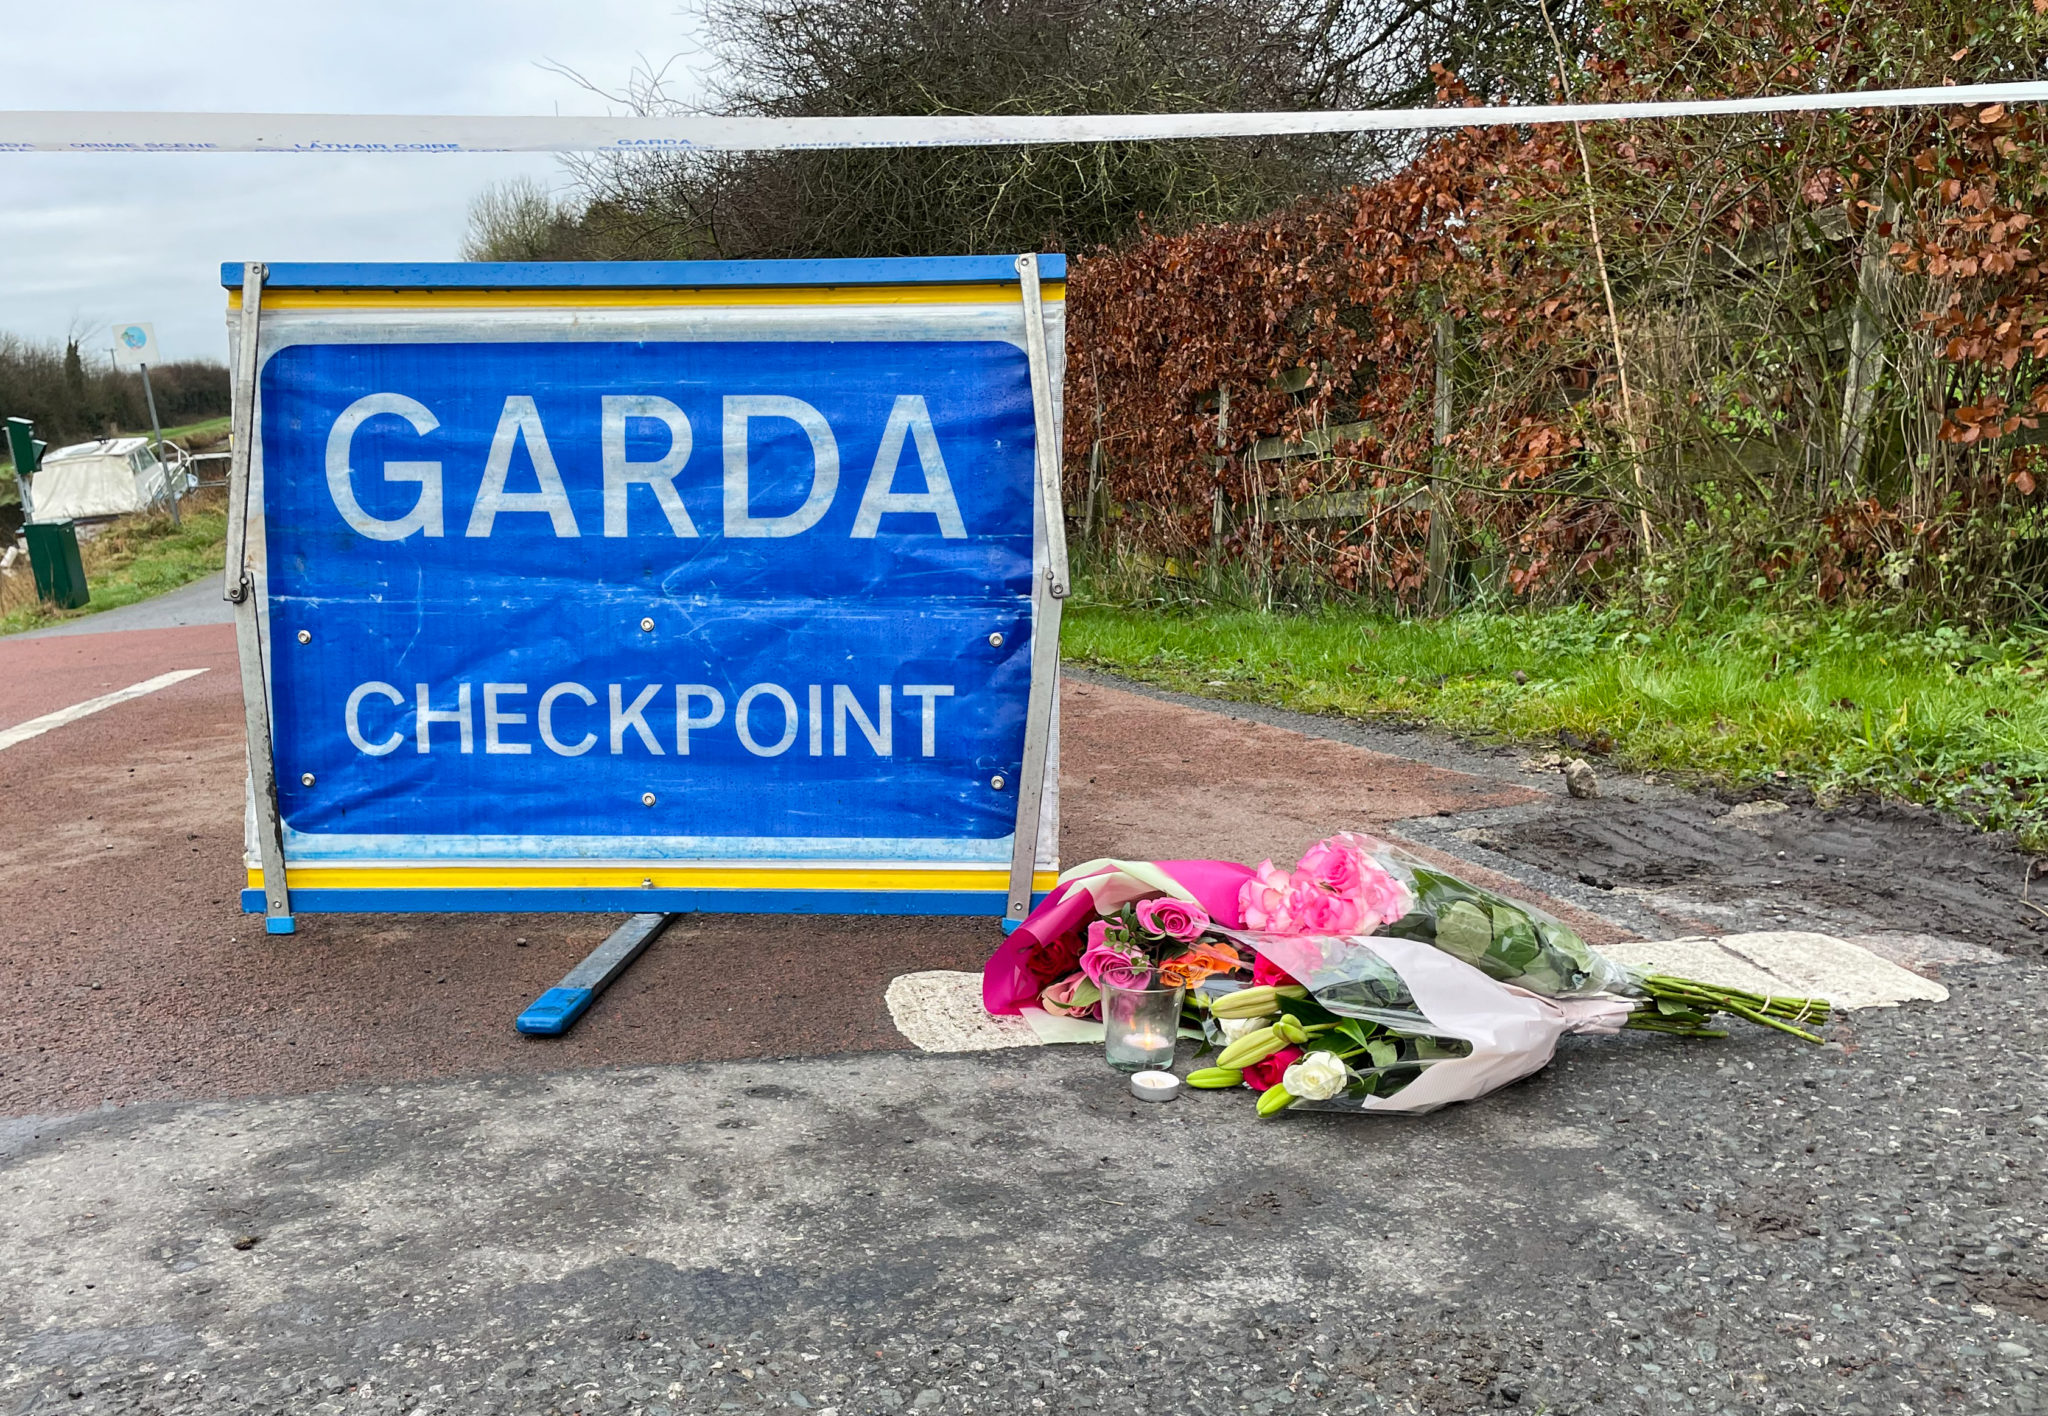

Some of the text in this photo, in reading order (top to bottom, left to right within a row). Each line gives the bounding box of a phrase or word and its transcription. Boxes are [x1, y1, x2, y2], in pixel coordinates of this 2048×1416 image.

[617, 138, 692, 146] GARDA
[325, 392, 968, 541] GARDA
[344, 681, 955, 757] CHECKPOINT
